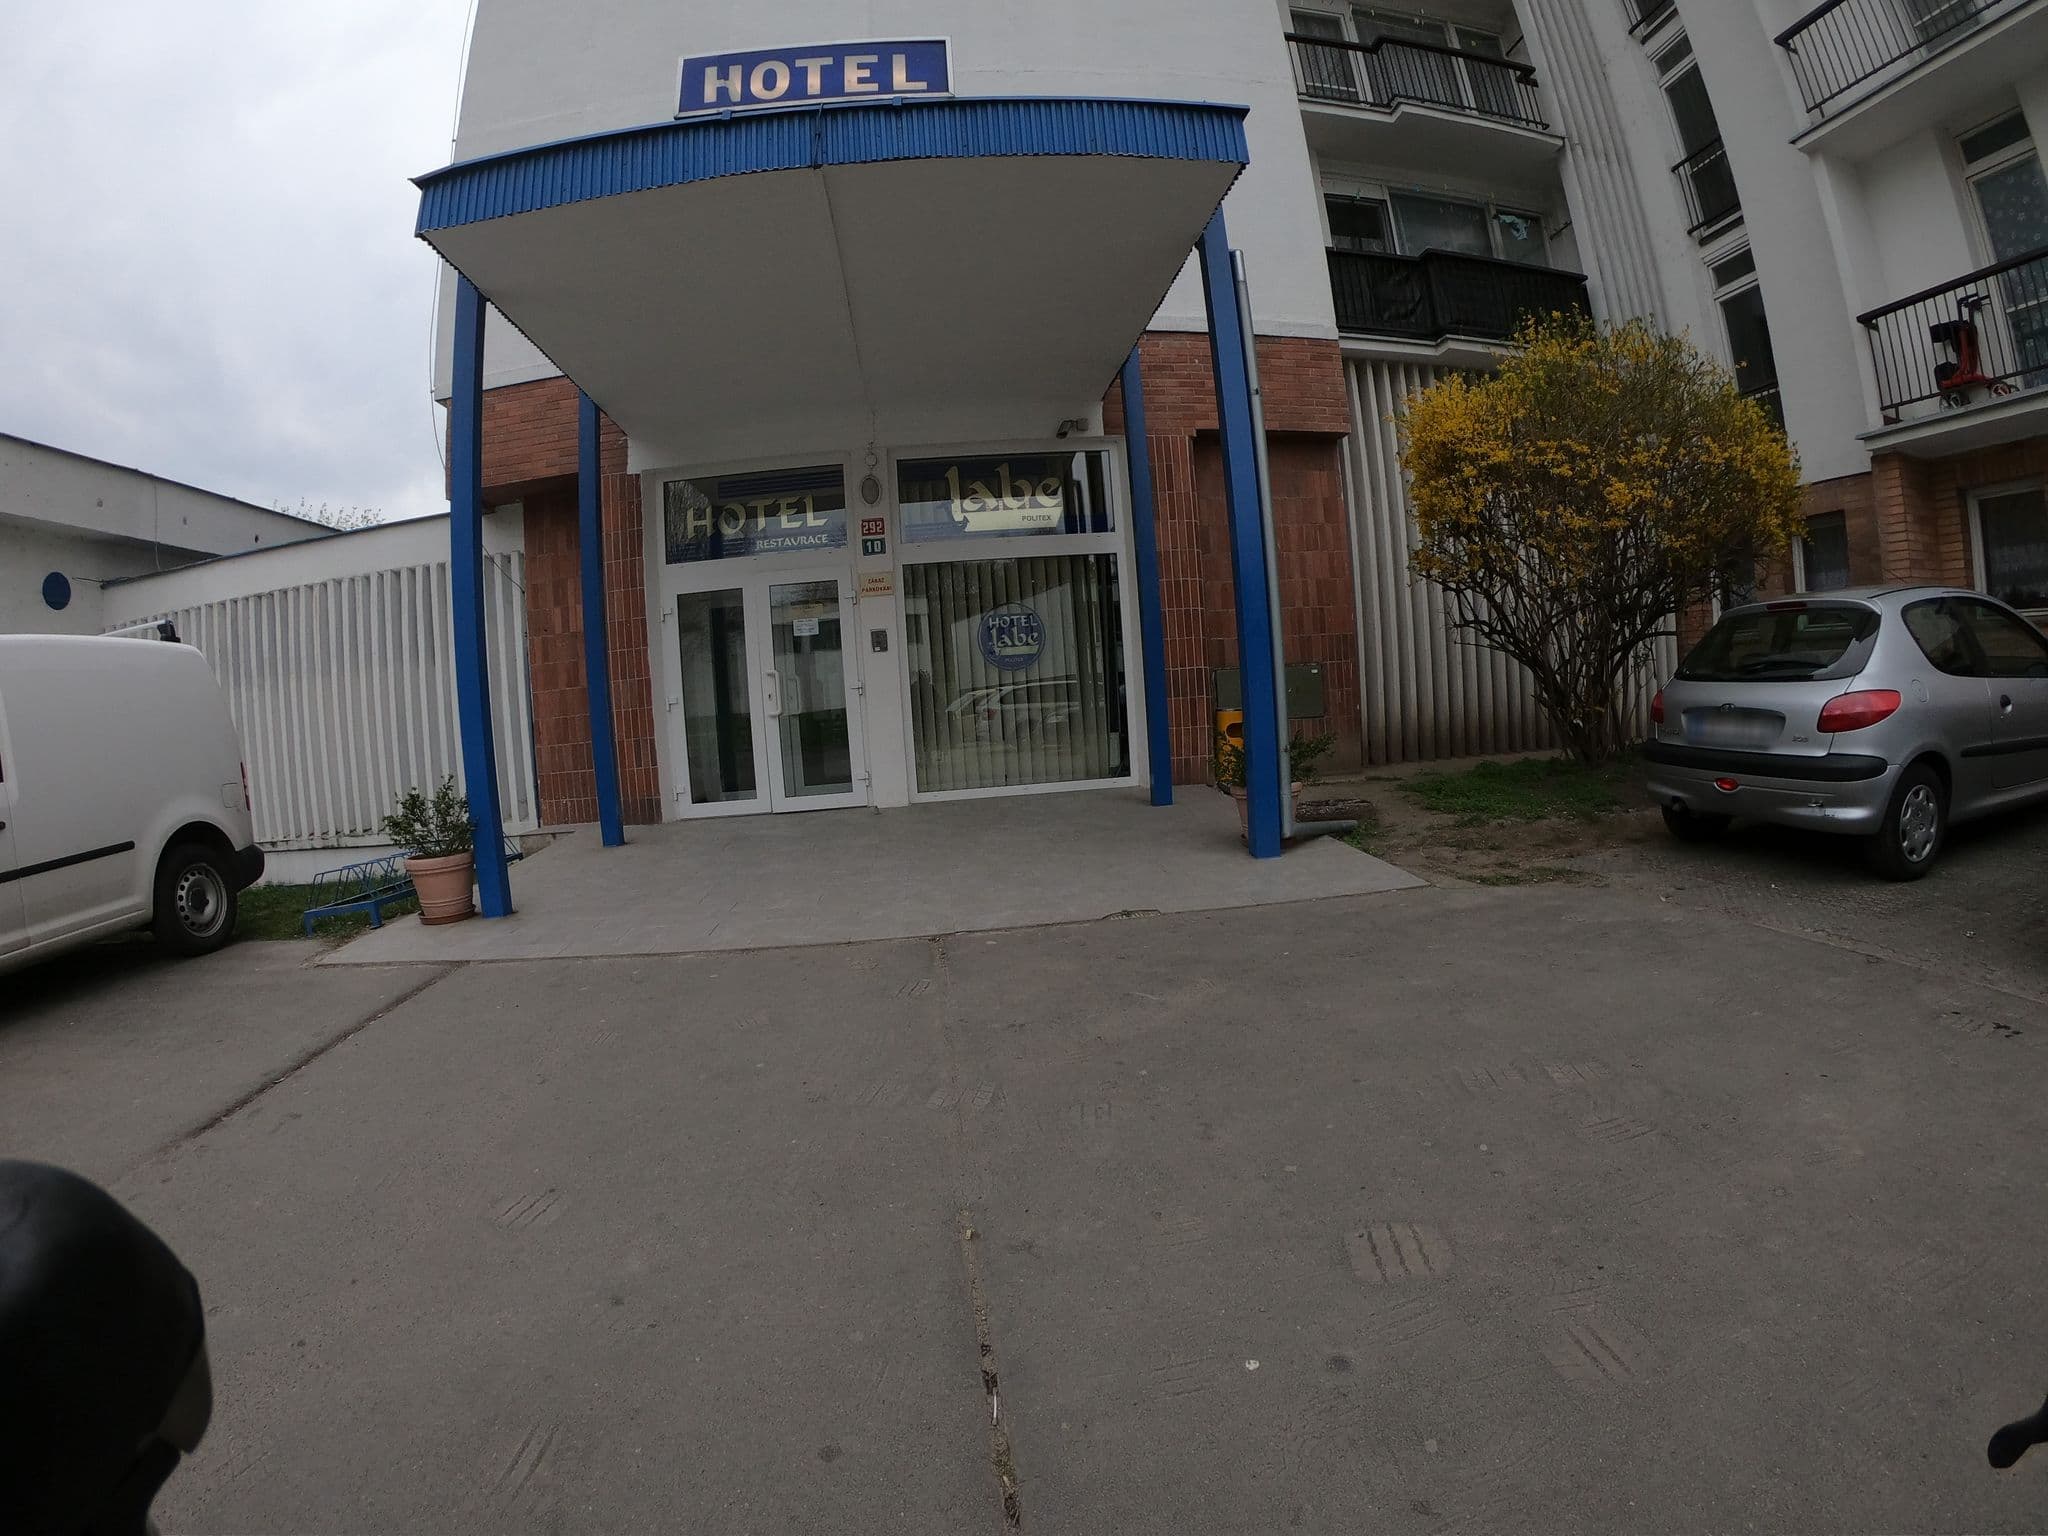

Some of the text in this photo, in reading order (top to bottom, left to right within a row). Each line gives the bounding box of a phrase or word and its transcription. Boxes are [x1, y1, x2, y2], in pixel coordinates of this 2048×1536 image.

[704, 54, 928, 103] HOTEL
[687, 495, 828, 539] HOTEL
[1021, 514, 1052, 522] POLITEX
[862, 521, 883, 533] 292
[756, 534, 828, 550] RESTAURACE
[866, 540, 881, 553] 10
[989, 614, 1038, 628] HOTEL
